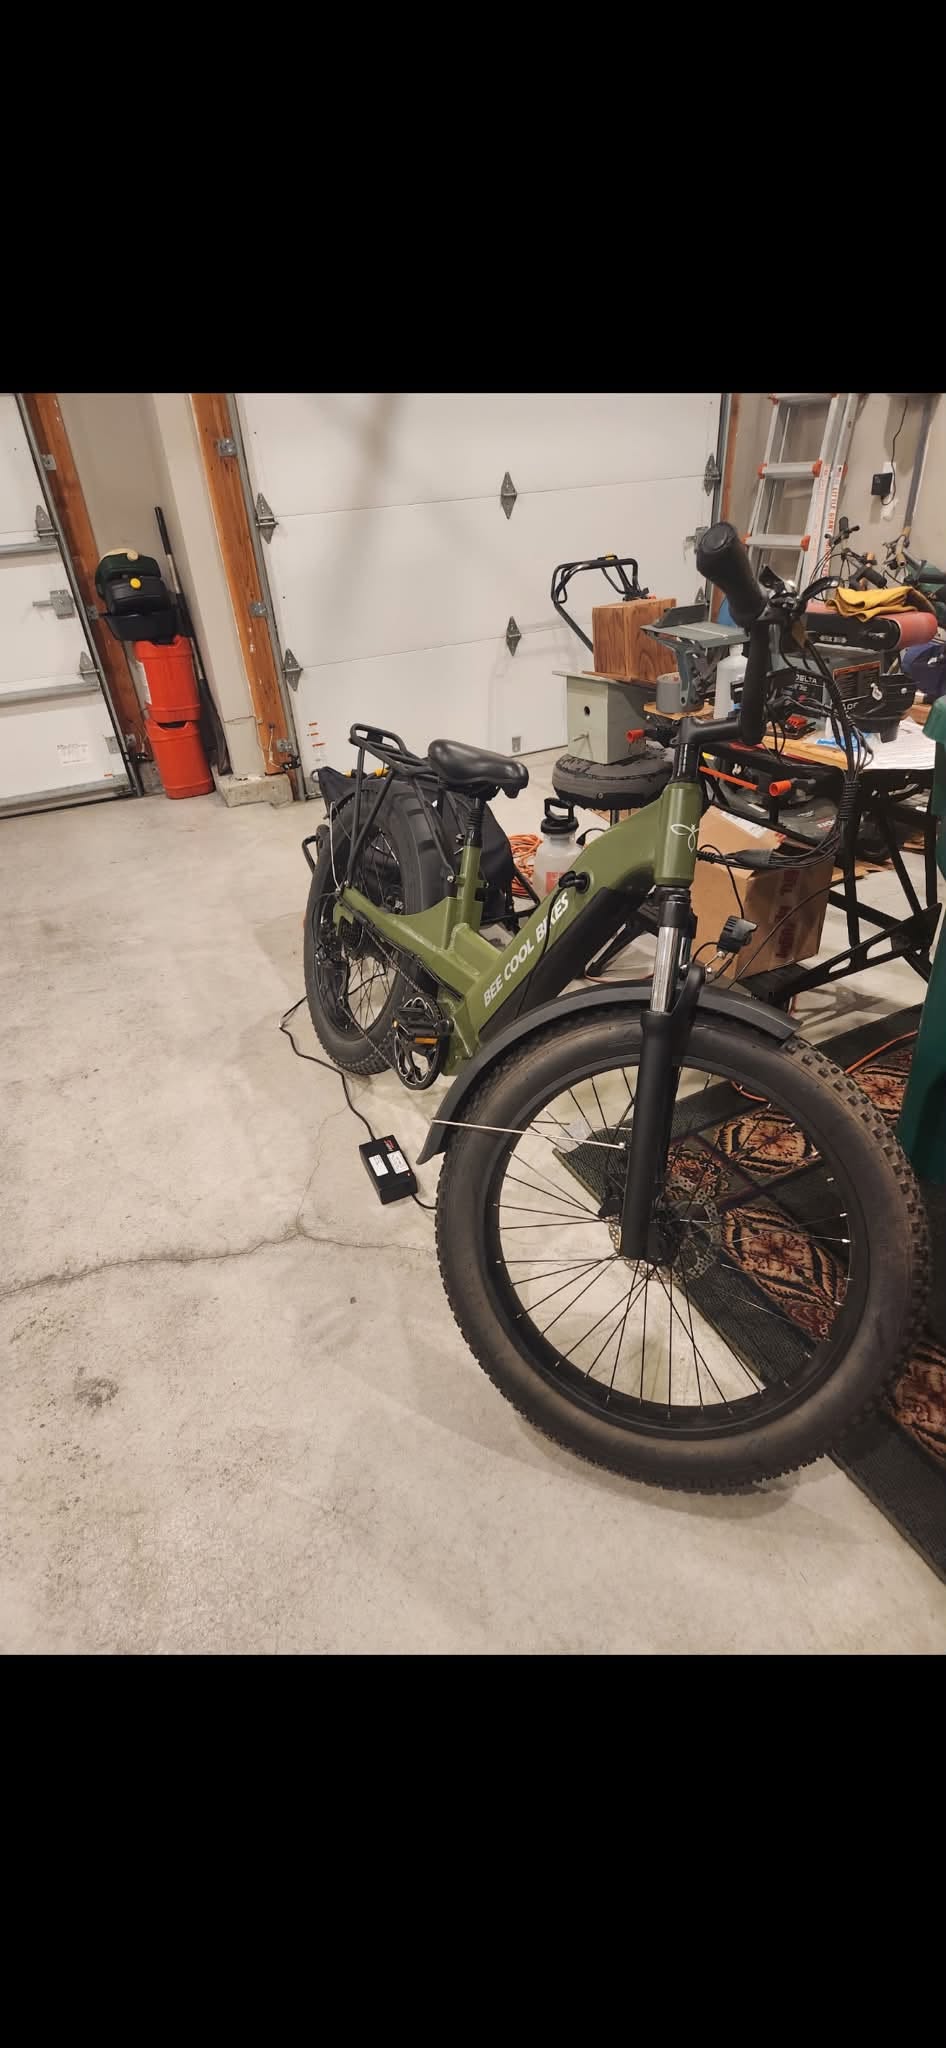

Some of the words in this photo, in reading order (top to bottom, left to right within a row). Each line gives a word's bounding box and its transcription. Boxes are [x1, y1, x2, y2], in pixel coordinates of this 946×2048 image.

[795, 673, 817, 684] DELTA
[484, 973, 503, 1008] BEE
[504, 938, 535, 981] COOL
